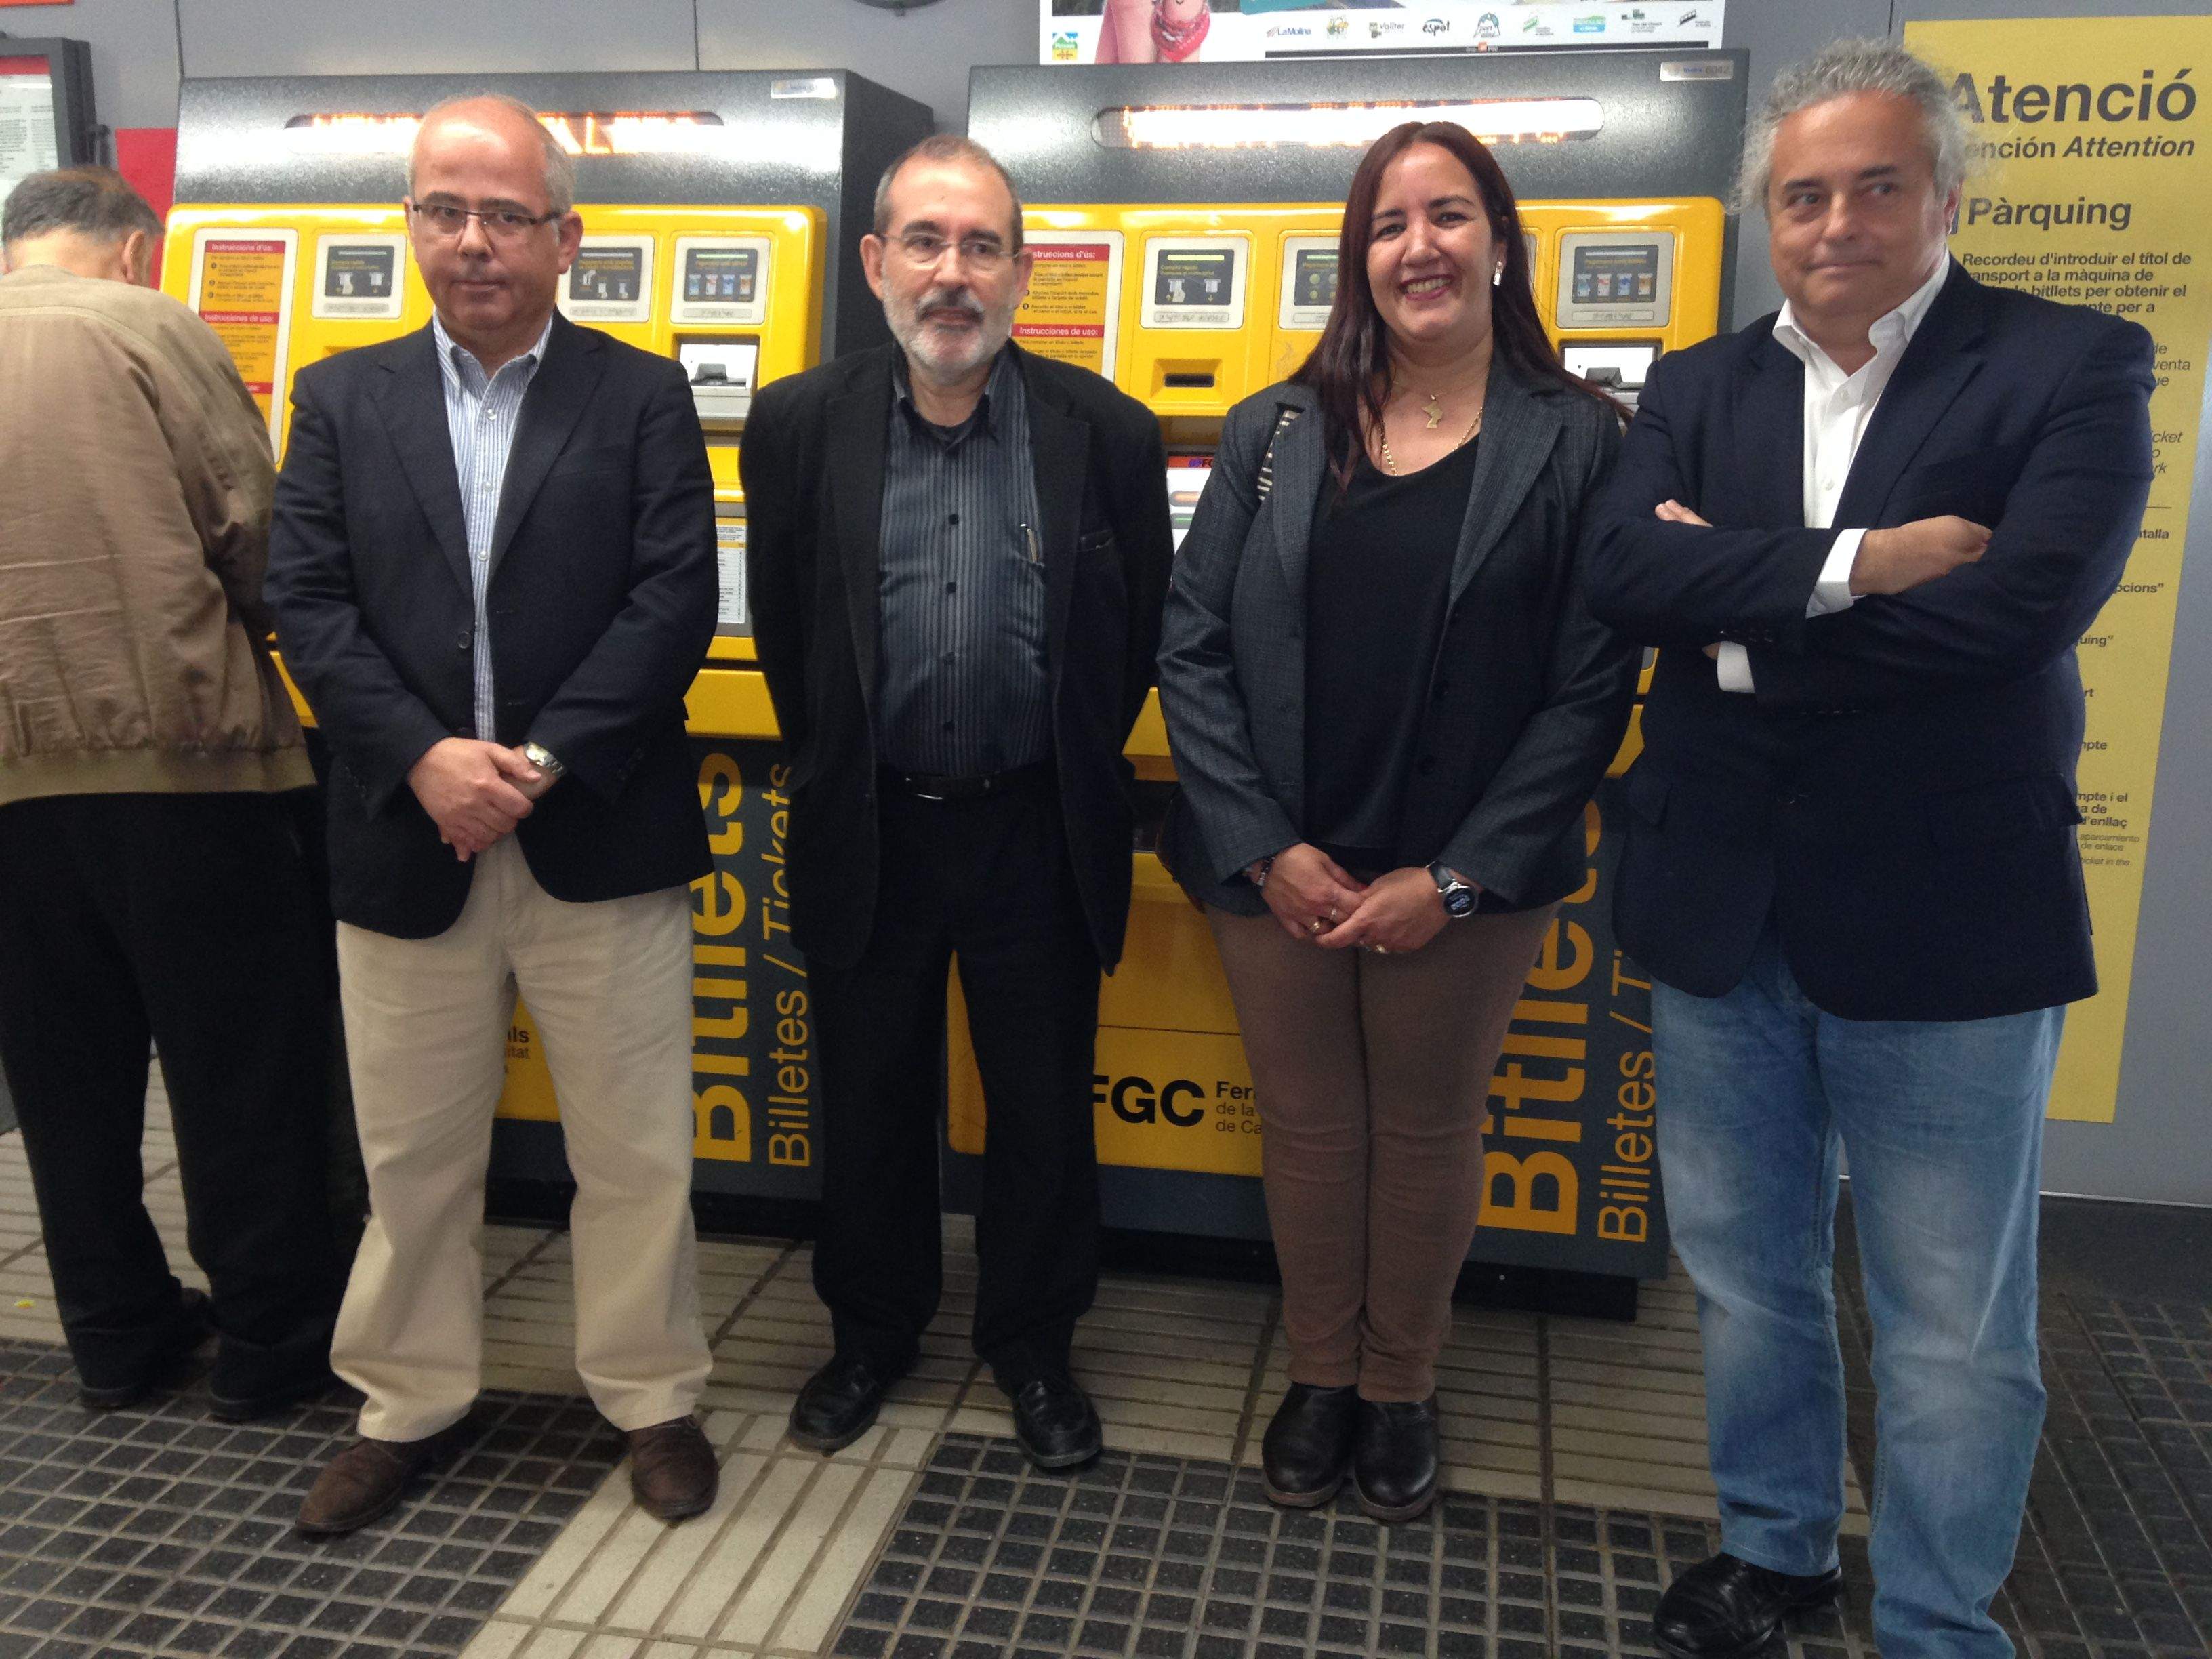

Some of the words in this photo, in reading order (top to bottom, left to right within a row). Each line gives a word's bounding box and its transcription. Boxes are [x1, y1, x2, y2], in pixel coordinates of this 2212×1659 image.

[1950, 68, 2197, 124] Atenció
[2063, 136, 2195, 157] Attention
[1967, 197, 2131, 231] Pàrquing
[1962, 253, 2036, 266] Recordeu
[2040, 253, 2118, 265] d'introduir
[2121, 253, 2135, 264] el
[2139, 253, 2168, 265] títol
[2172, 252, 2192, 264] de
[2033, 272, 2043, 281] a
[2047, 269, 2060, 281] la
[2064, 269, 2131, 283] màquina
[2135, 269, 2154, 281] de
[2032, 285, 2081, 298] bitllets
[2085, 287, 2110, 300] per
[2115, 285, 2169, 297] obtenir
[2173, 285, 2187, 296] el
[2116, 303, 2142, 316] per
[2146, 302, 2155, 312] a
[1019, 327, 1069, 335] Instrucciones
[2154, 462, 2168, 474] rk
[2115, 582, 2164, 594] pcions"
[2079, 635, 2114, 647] uing"
[2084, 688, 2094, 697] rt
[2110, 792, 2114, 802] i
[2116, 792, 2128, 802] el
[2081, 805, 2087, 813] a
[2091, 804, 2108, 814] de
[767, 990, 811, 1167] Billetes
[1216, 1081, 1256, 1100] Fer
[1091, 1074, 1205, 1128] FGC
[1216, 1102, 1236, 1115] de
[1242, 1103, 1254, 1117] la
[1216, 1120, 1235, 1132] de
[1241, 1120, 1262, 1134] Ca
[1597, 1051, 1656, 1243] Billetes
